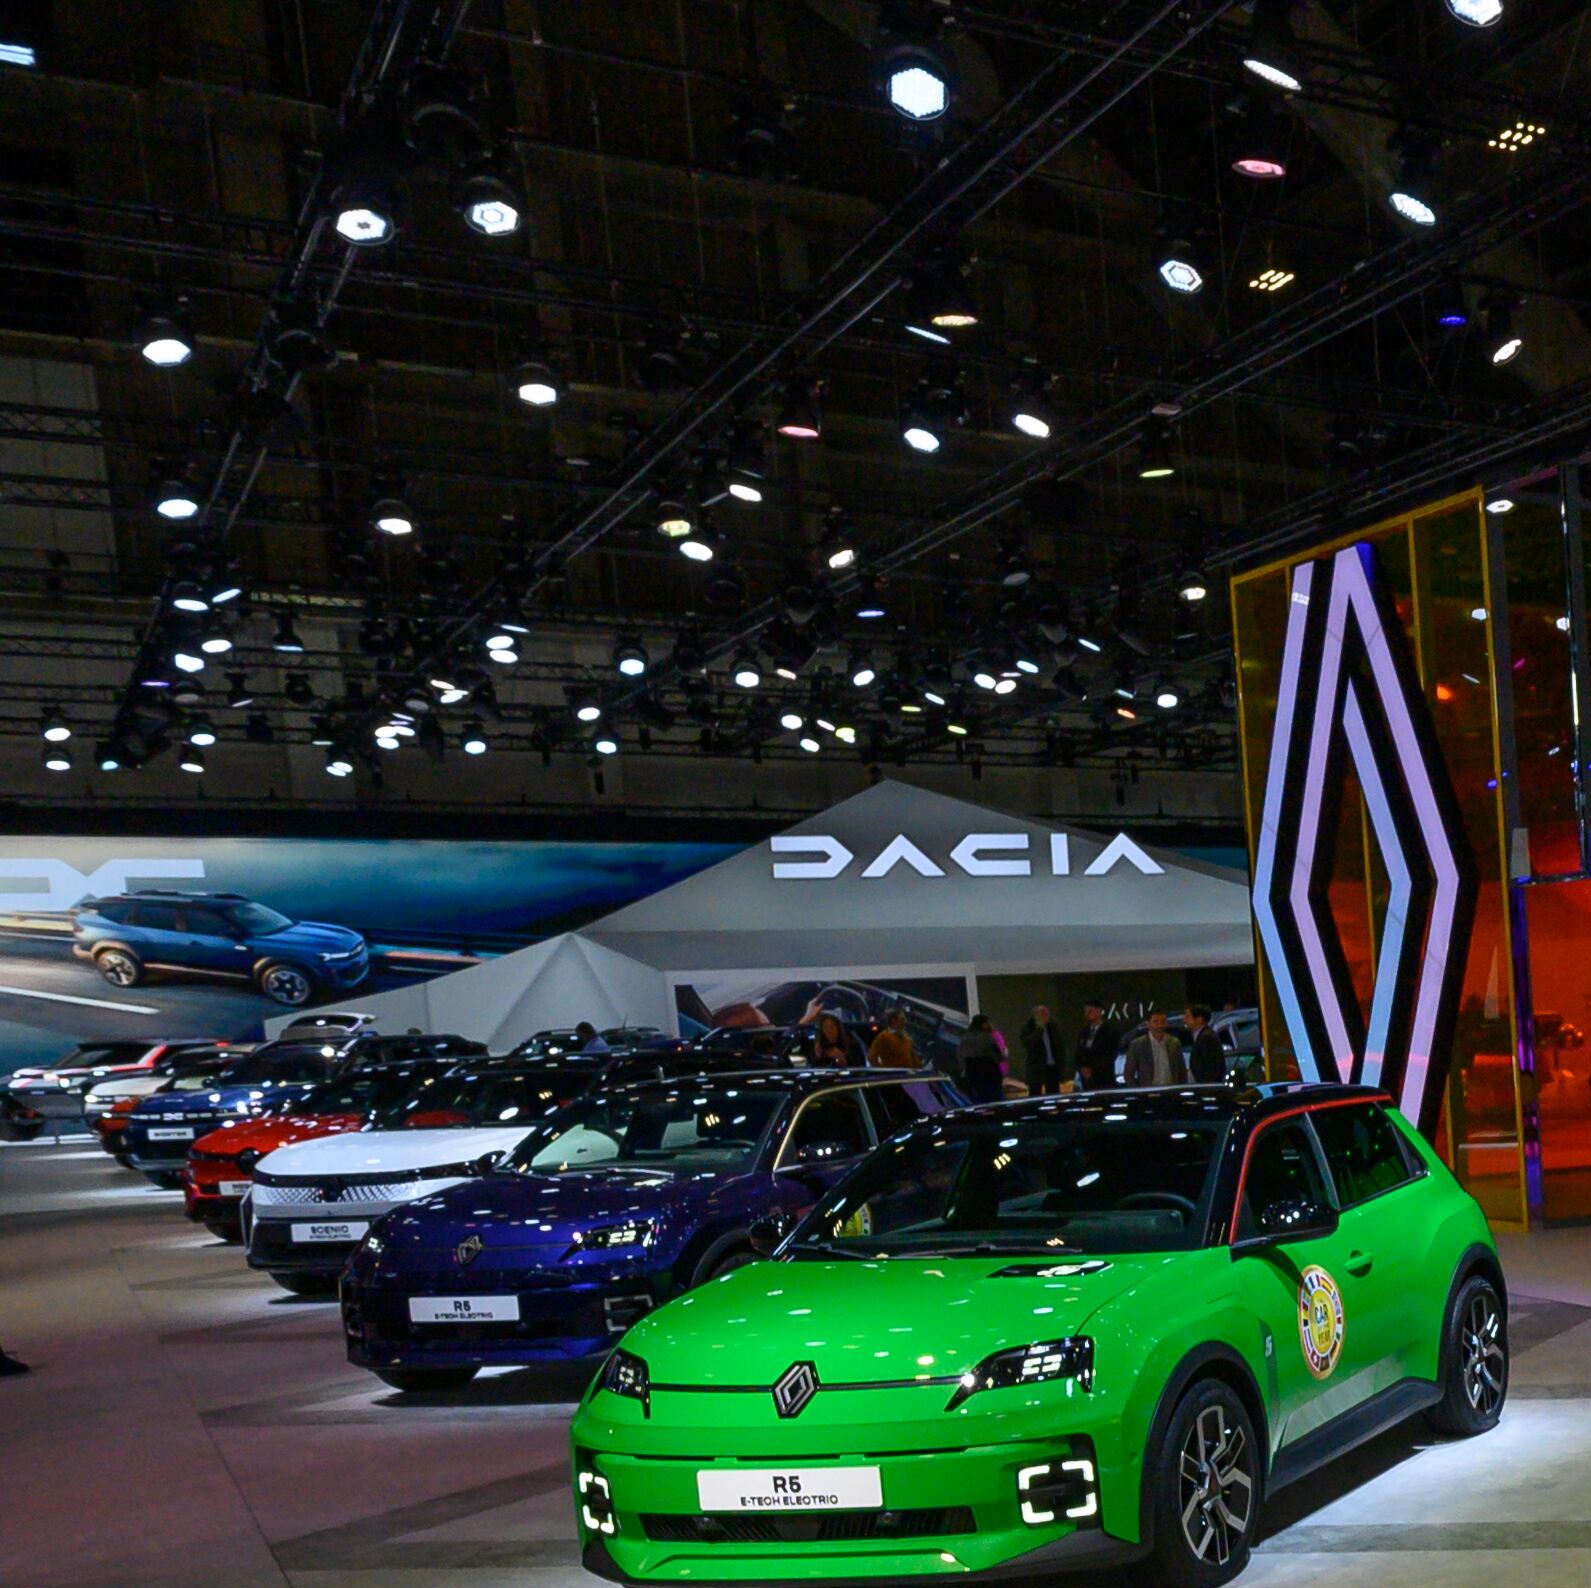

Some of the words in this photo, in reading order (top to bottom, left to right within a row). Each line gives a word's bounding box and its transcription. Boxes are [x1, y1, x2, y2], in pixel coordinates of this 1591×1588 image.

[770, 832, 1165, 879] DACIA
[453, 1301, 471, 1312] R5
[1315, 1304, 1328, 1324] CAR
[773, 1476, 801, 1493] R5
